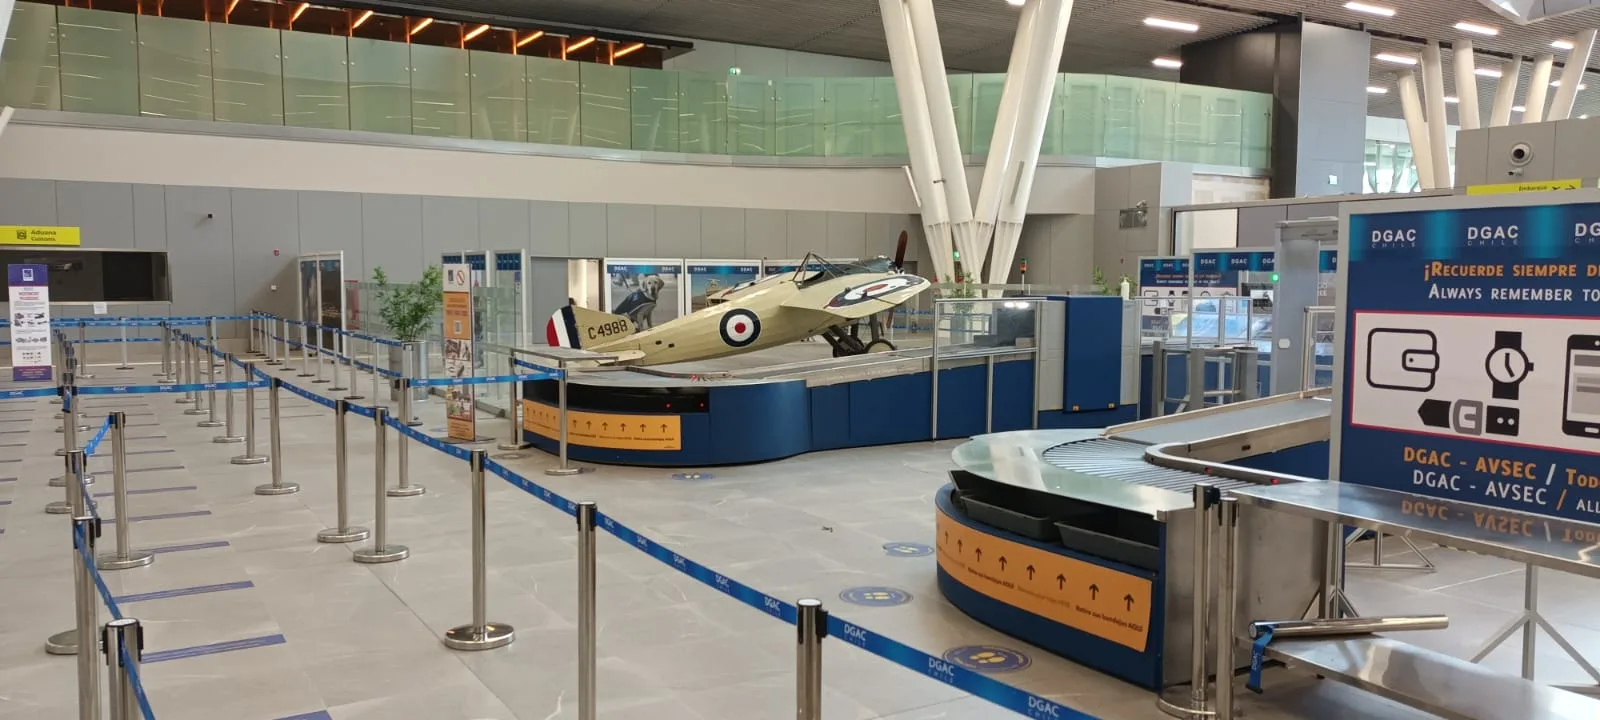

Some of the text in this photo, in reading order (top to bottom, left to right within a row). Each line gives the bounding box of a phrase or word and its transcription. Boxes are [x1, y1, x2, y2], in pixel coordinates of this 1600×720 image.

[1372, 229, 1417, 243] DGAC
[1467, 225, 1519, 240] DGAC
[1513, 264, 1577, 277] SIEMPRE
[1428, 283, 1482, 300] ALWAYS
[1491, 288, 1573, 302] REMEMBER
[1404, 446, 1451, 467] DGAC
[1475, 456, 1537, 480] AVSEC
[1565, 468, 1600, 488] TOD
[1413, 470, 1461, 491] DGAC
[1485, 481, 1547, 505] AVSEC
[843, 623, 867, 642] DGAC
[928, 657, 954, 676] DGAC
[1028, 695, 1060, 717] DGAC
